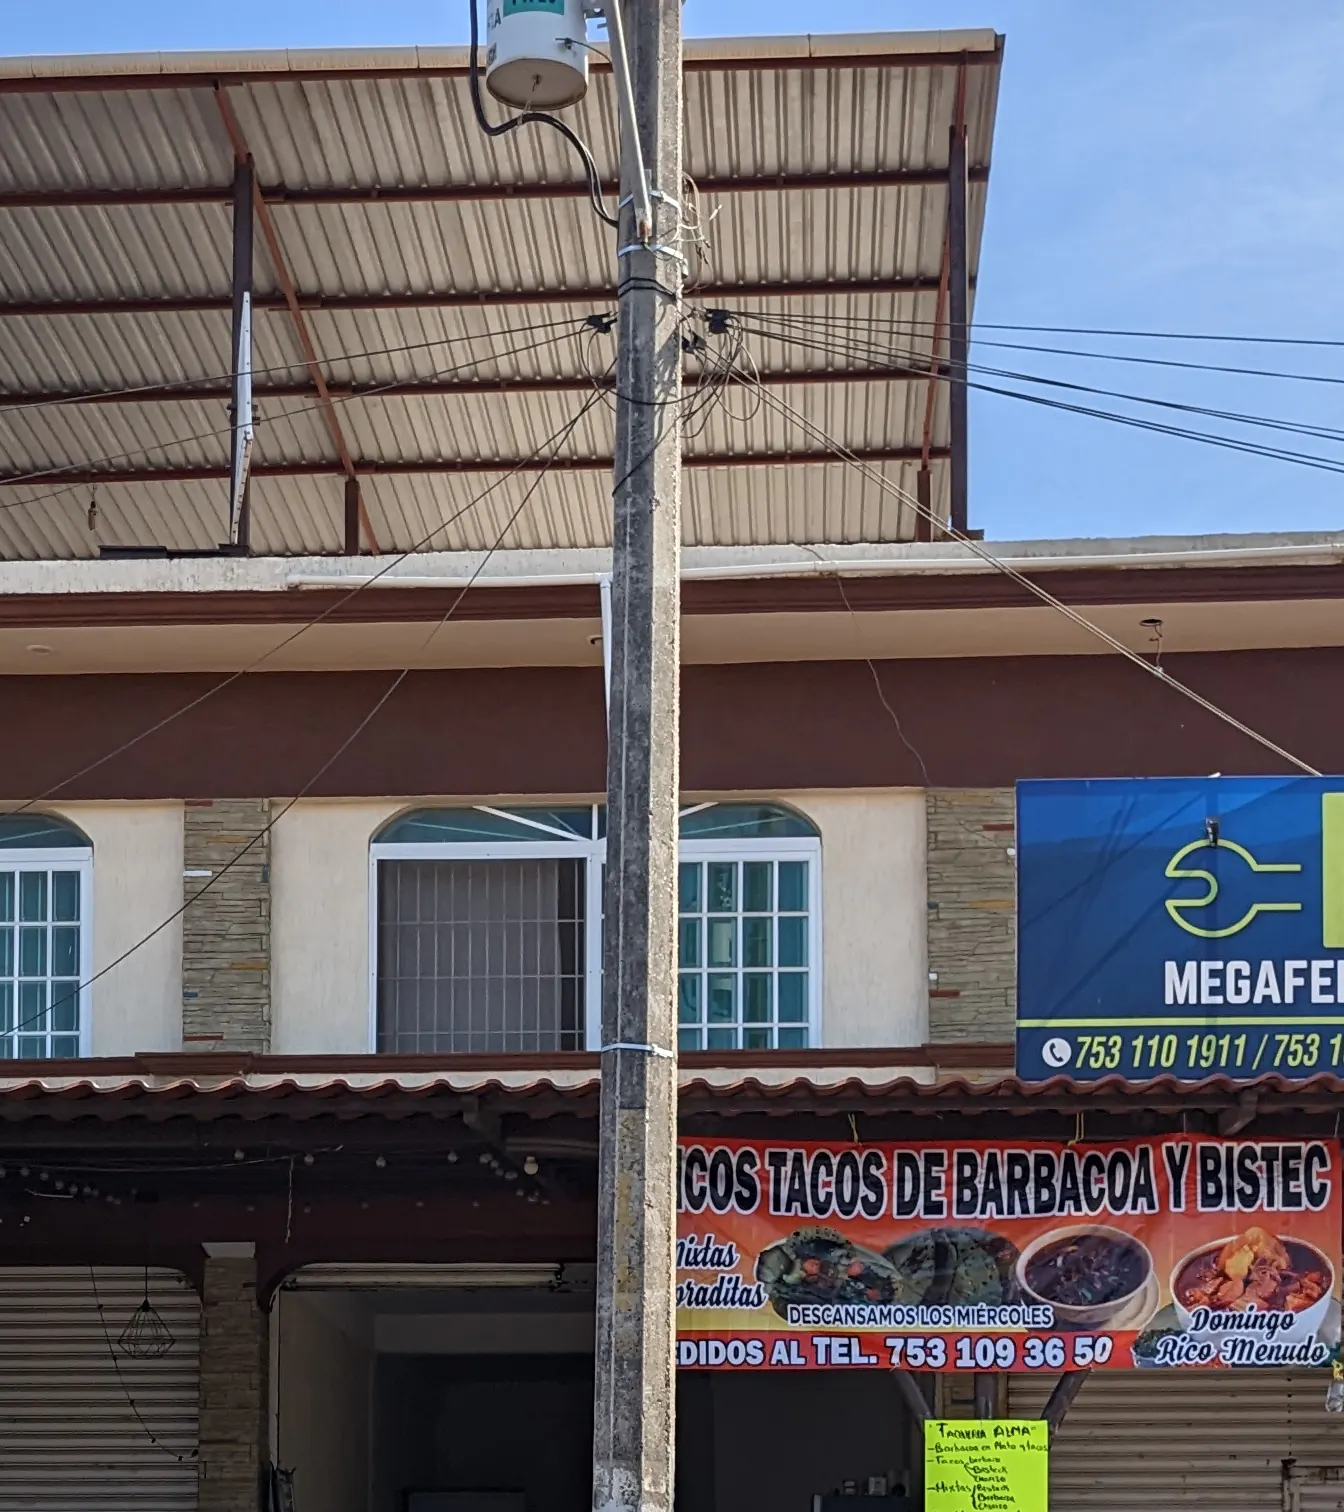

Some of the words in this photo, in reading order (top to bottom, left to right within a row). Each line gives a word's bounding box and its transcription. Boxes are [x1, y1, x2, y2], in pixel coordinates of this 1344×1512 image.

[1076, 1035, 1122, 1068] 753
[1131, 1034, 1177, 1068] 110
[1186, 1033, 1247, 1068] 1911
[1273, 1033, 1320, 1067] 753
[676, 1147, 759, 1213] ICOS
[765, 1149, 887, 1219] TACOS
[893, 1149, 947, 1219] DE
[954, 1144, 1159, 1219] BARBACOA
[1162, 1141, 1191, 1212] Y
[1197, 1141, 1331, 1212] BISTEC
[788, 1305, 916, 1327] DESCANSAMOS
[920, 1305, 953, 1326] LOS
[958, 1302, 1054, 1327] MIÉRCOLES
[1190, 1304, 1294, 1339] Domingo
[676, 1340, 765, 1366] DIDOS
[771, 1340, 807, 1366] AL
[813, 1336, 878, 1366] TEL.
[886, 1337, 946, 1368] 753
[956, 1337, 1017, 1367] 109
[1025, 1337, 1065, 1367] 36
[1074, 1337, 1113, 1367] 50
[1158, 1336, 1213, 1363] Rico
[1222, 1336, 1327, 1363] Menudo
